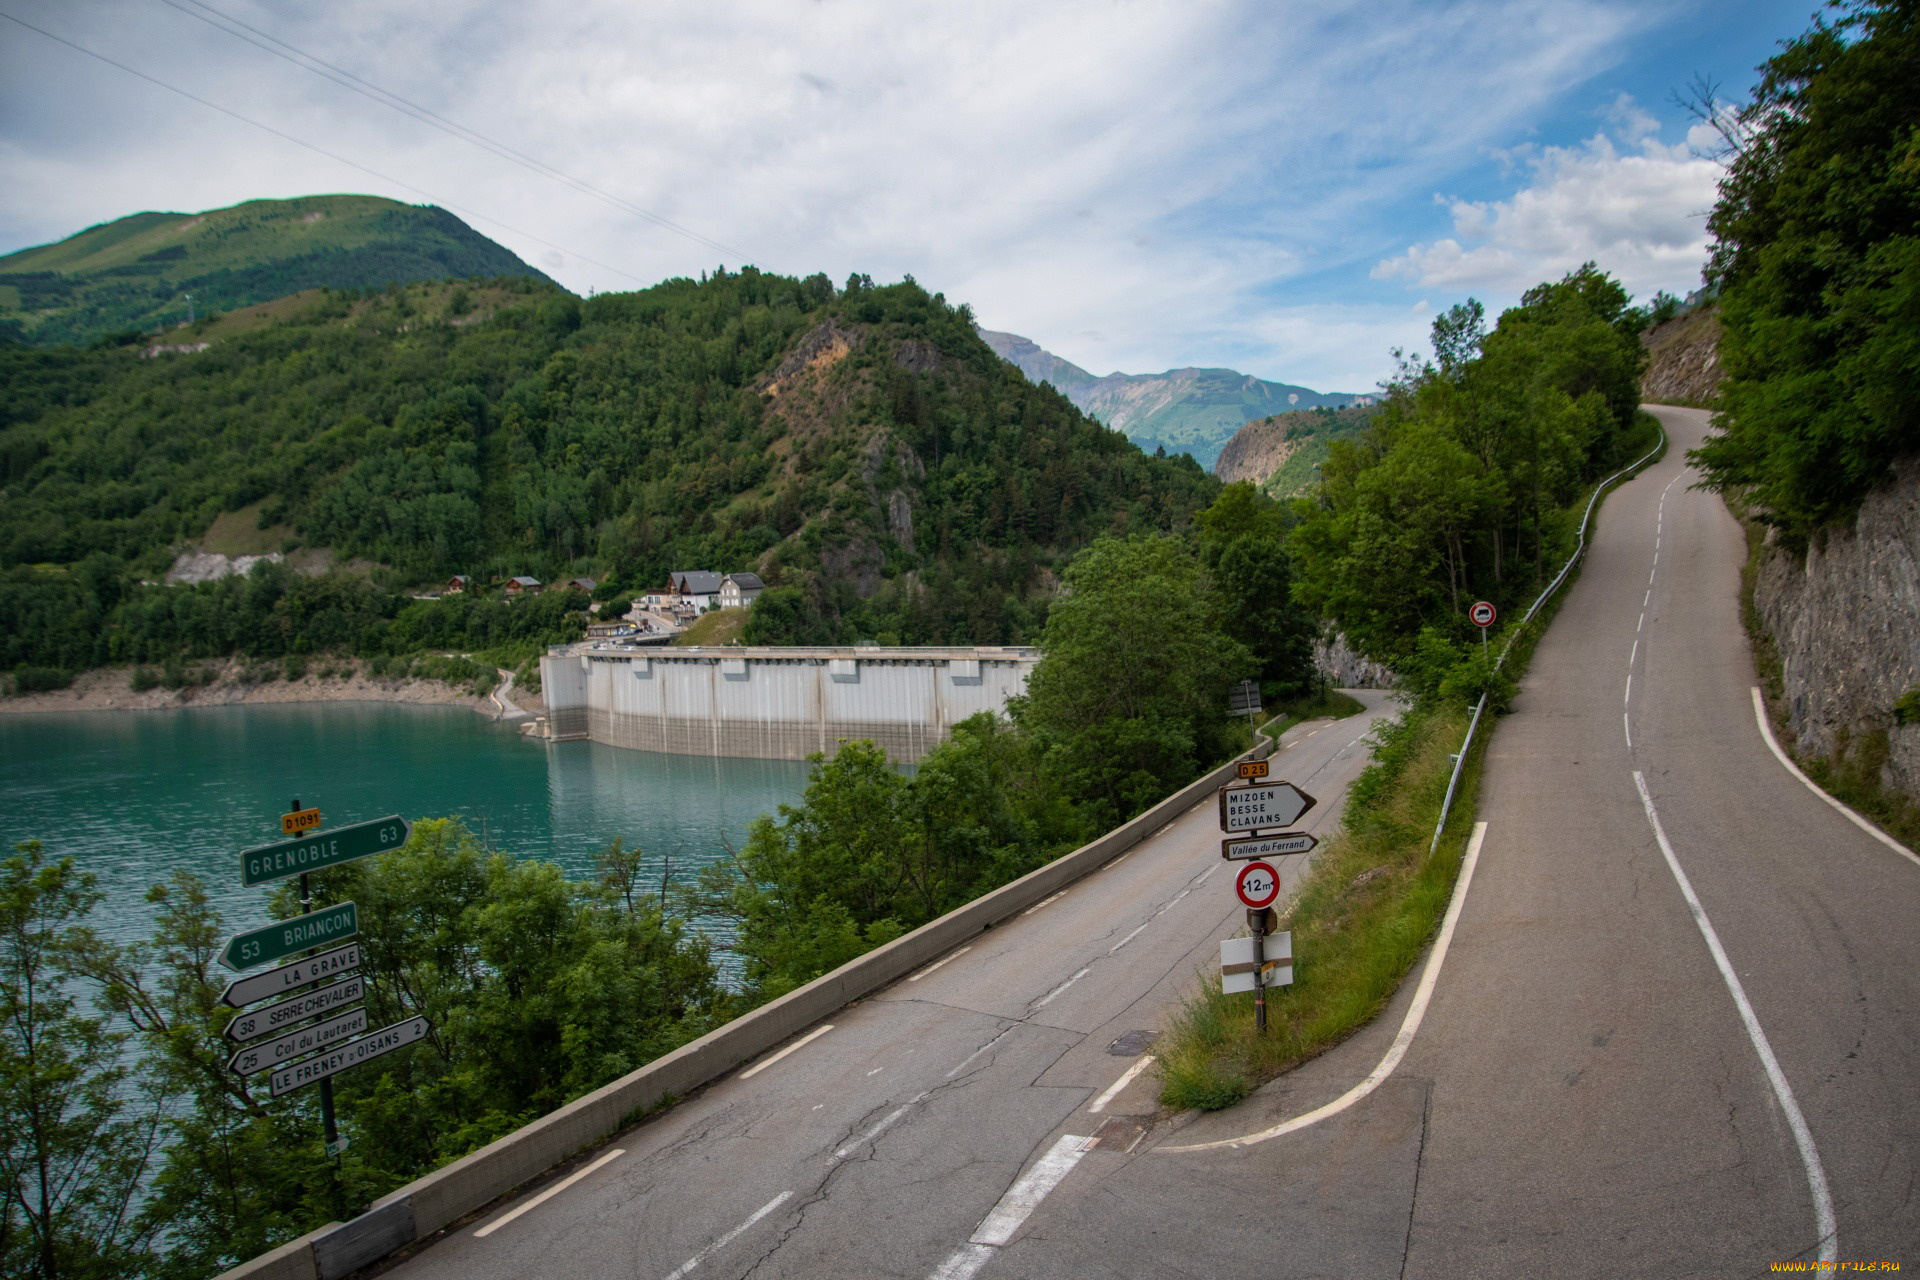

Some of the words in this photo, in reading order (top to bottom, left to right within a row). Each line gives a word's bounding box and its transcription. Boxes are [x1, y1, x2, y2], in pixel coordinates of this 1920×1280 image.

[1230, 791, 1274, 804] MIZOEN
[1230, 804, 1266, 816] BESSE
[1231, 814, 1280, 827] CLAVANS
[250, 840, 339, 876] GRENOBLE
[379, 826, 397, 843] 63
[1232, 844, 1258, 855] Vallée
[1260, 843, 1270, 852] du
[1272, 839, 1304, 850] Ferrand
[241, 940, 260, 960] 53
[284, 911, 351, 946] BRIANÇON
[284, 969, 302, 985] LA
[311, 951, 355, 976] GRAVE
[240, 1019, 256, 1036] 38
[242, 1053, 258, 1071] 25
[275, 1042, 295, 1058] Col
[300, 1035, 313, 1050] du
[316, 1016, 362, 1043] Lautaret
[276, 1073, 291, 1090] LE
[296, 1053, 344, 1082] FRENEY
[414, 1023, 422, 1036] 2
